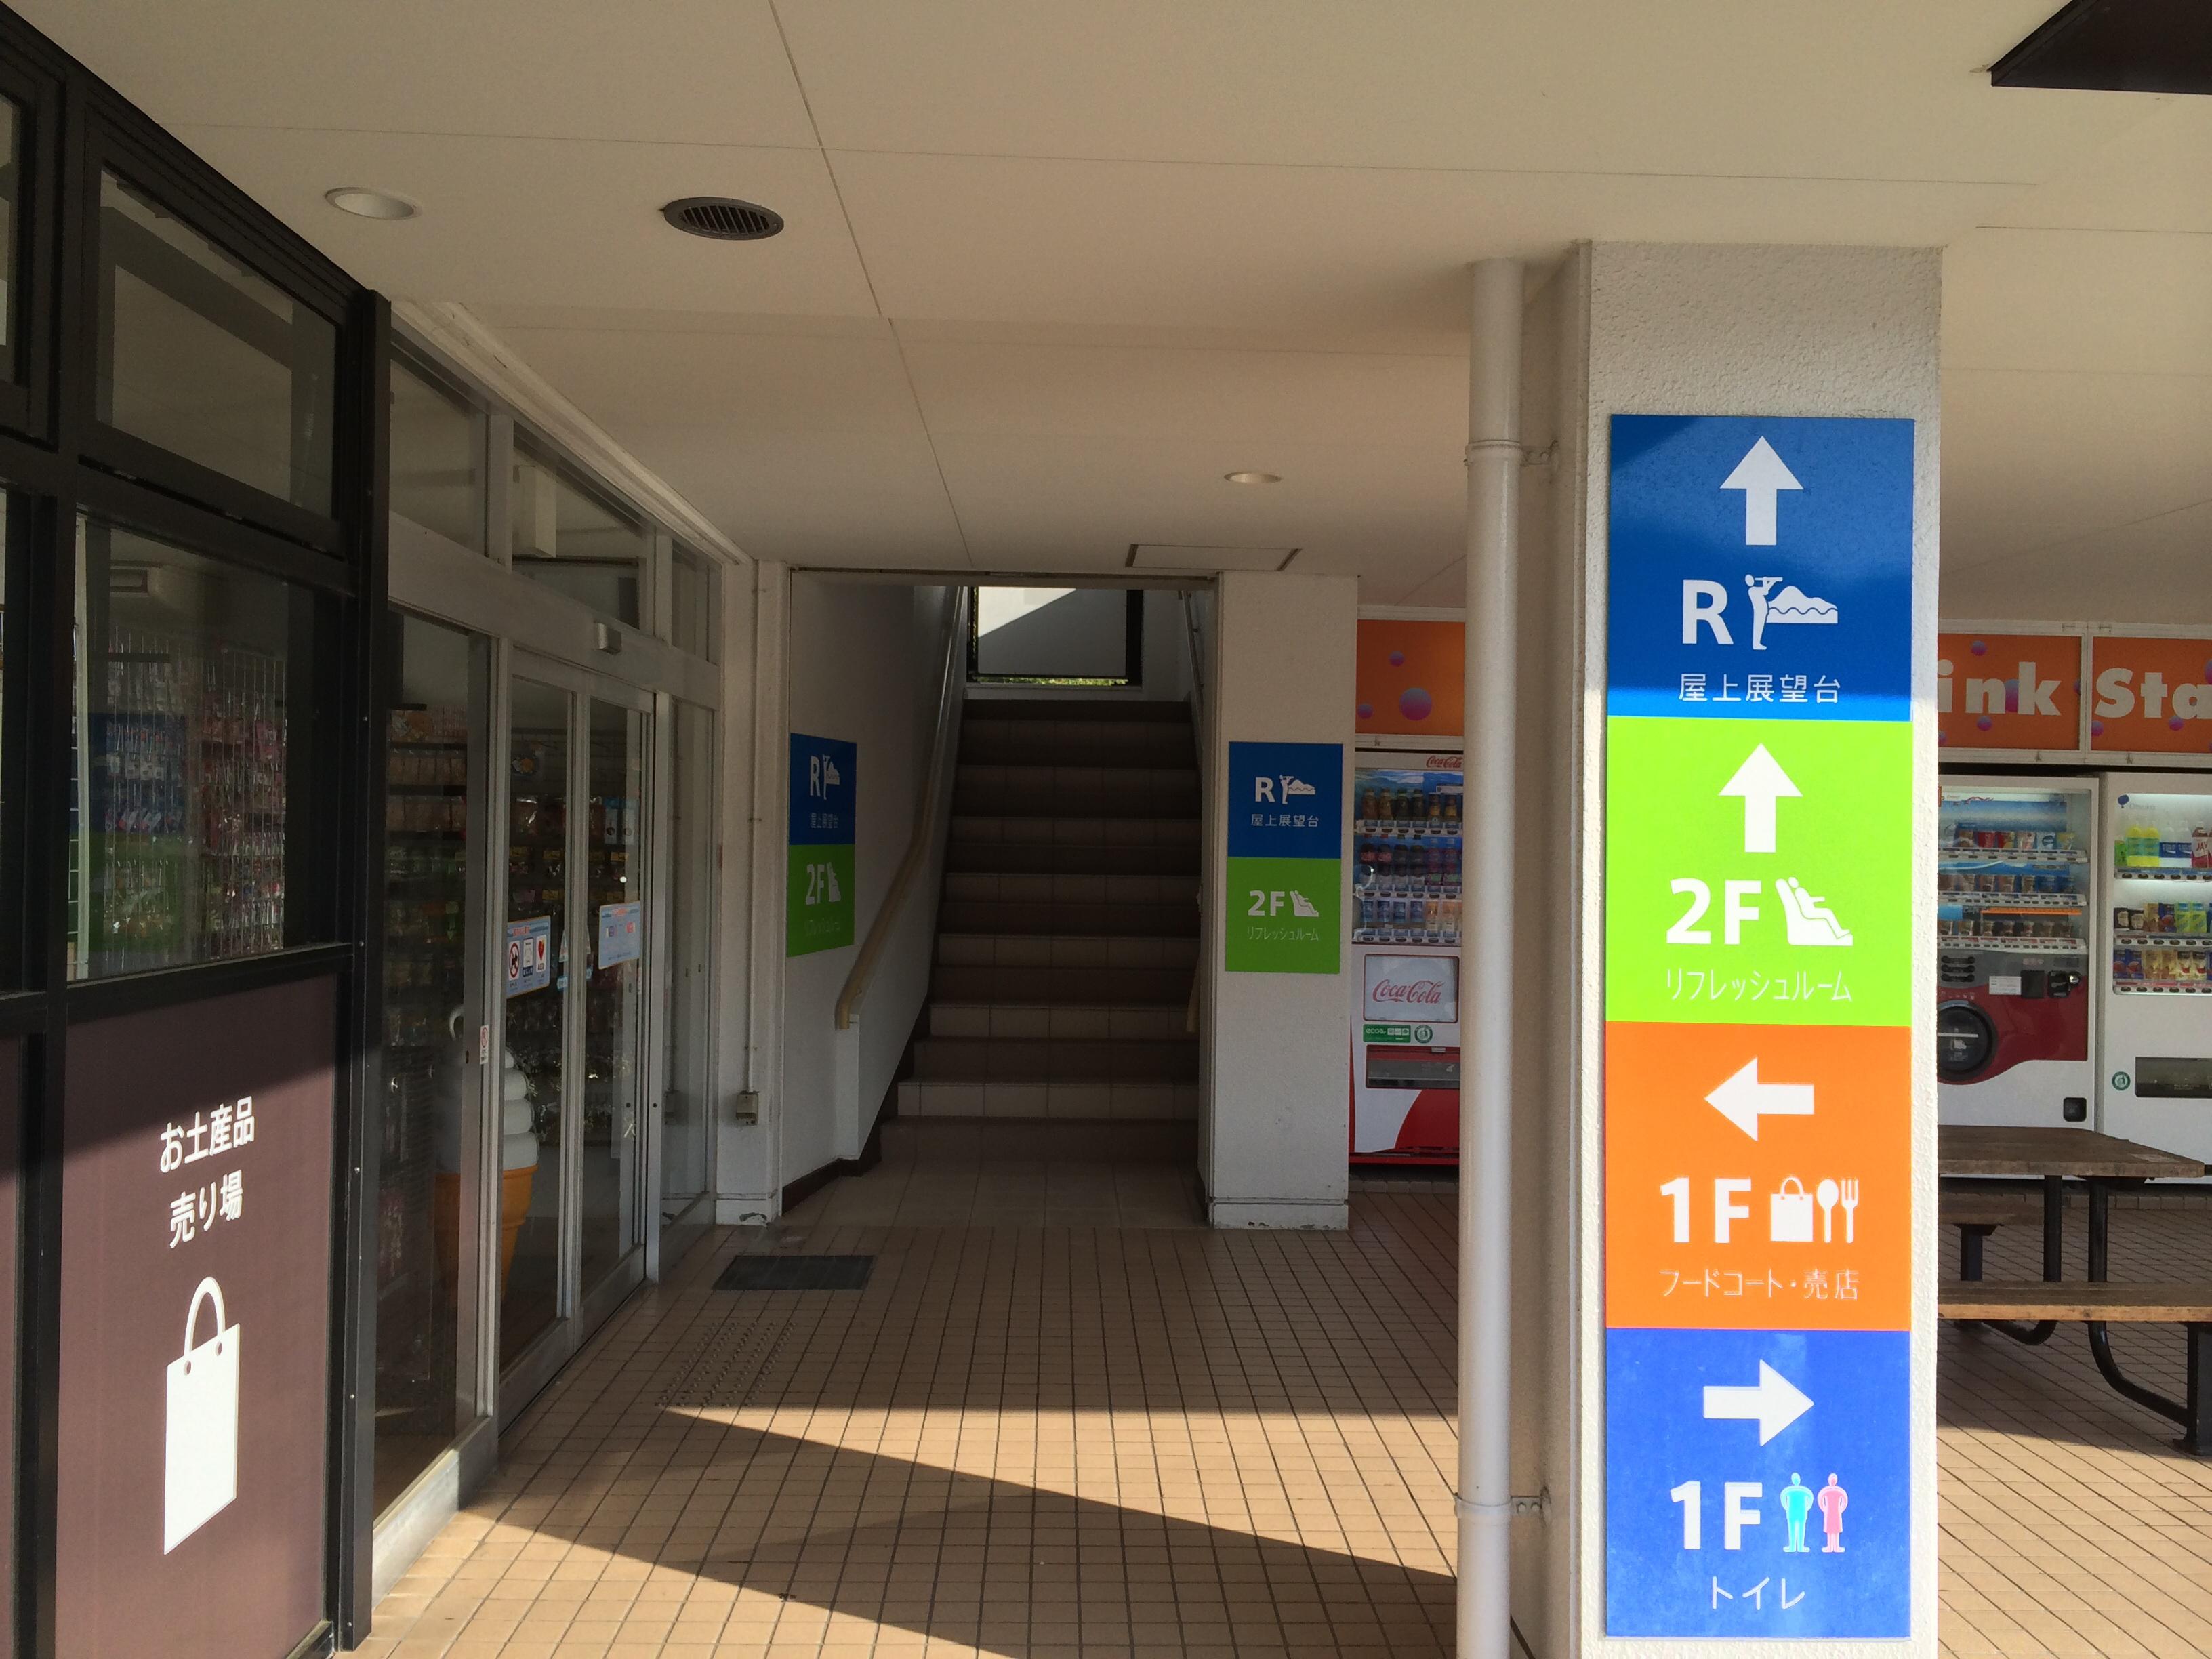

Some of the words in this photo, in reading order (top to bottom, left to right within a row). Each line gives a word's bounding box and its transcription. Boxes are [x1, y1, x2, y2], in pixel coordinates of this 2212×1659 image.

[1682, 579, 1734, 645] R
[1678, 674, 1841, 704] 屋上展望台
[2094, 668, 2212, 720] Sta
[809, 756, 821, 797] R
[1426, 755, 1462, 769] Coca-Cola
[1254, 776, 1275, 804] R
[1251, 814, 1319, 828] 屋上展望台
[806, 863, 825, 905] 2F
[1248, 890, 1285, 917] 2F
[1666, 877, 1762, 945] 2F
[1247, 926, 1319, 941] リフレッシュルーム
[1372, 979, 1446, 1004] Coca-Cola
[1666, 968, 1852, 1002] リフレッシュルーム
[160, 1095, 255, 1174] お土産品
[169, 1170, 243, 1249] 売り場
[1659, 1176, 1752, 1244] 1F
[1659, 1268, 1860, 1300] フードコート・売店
[1670, 1481, 1763, 1550] 1F
[1713, 1576, 1805, 1610] トイレ
